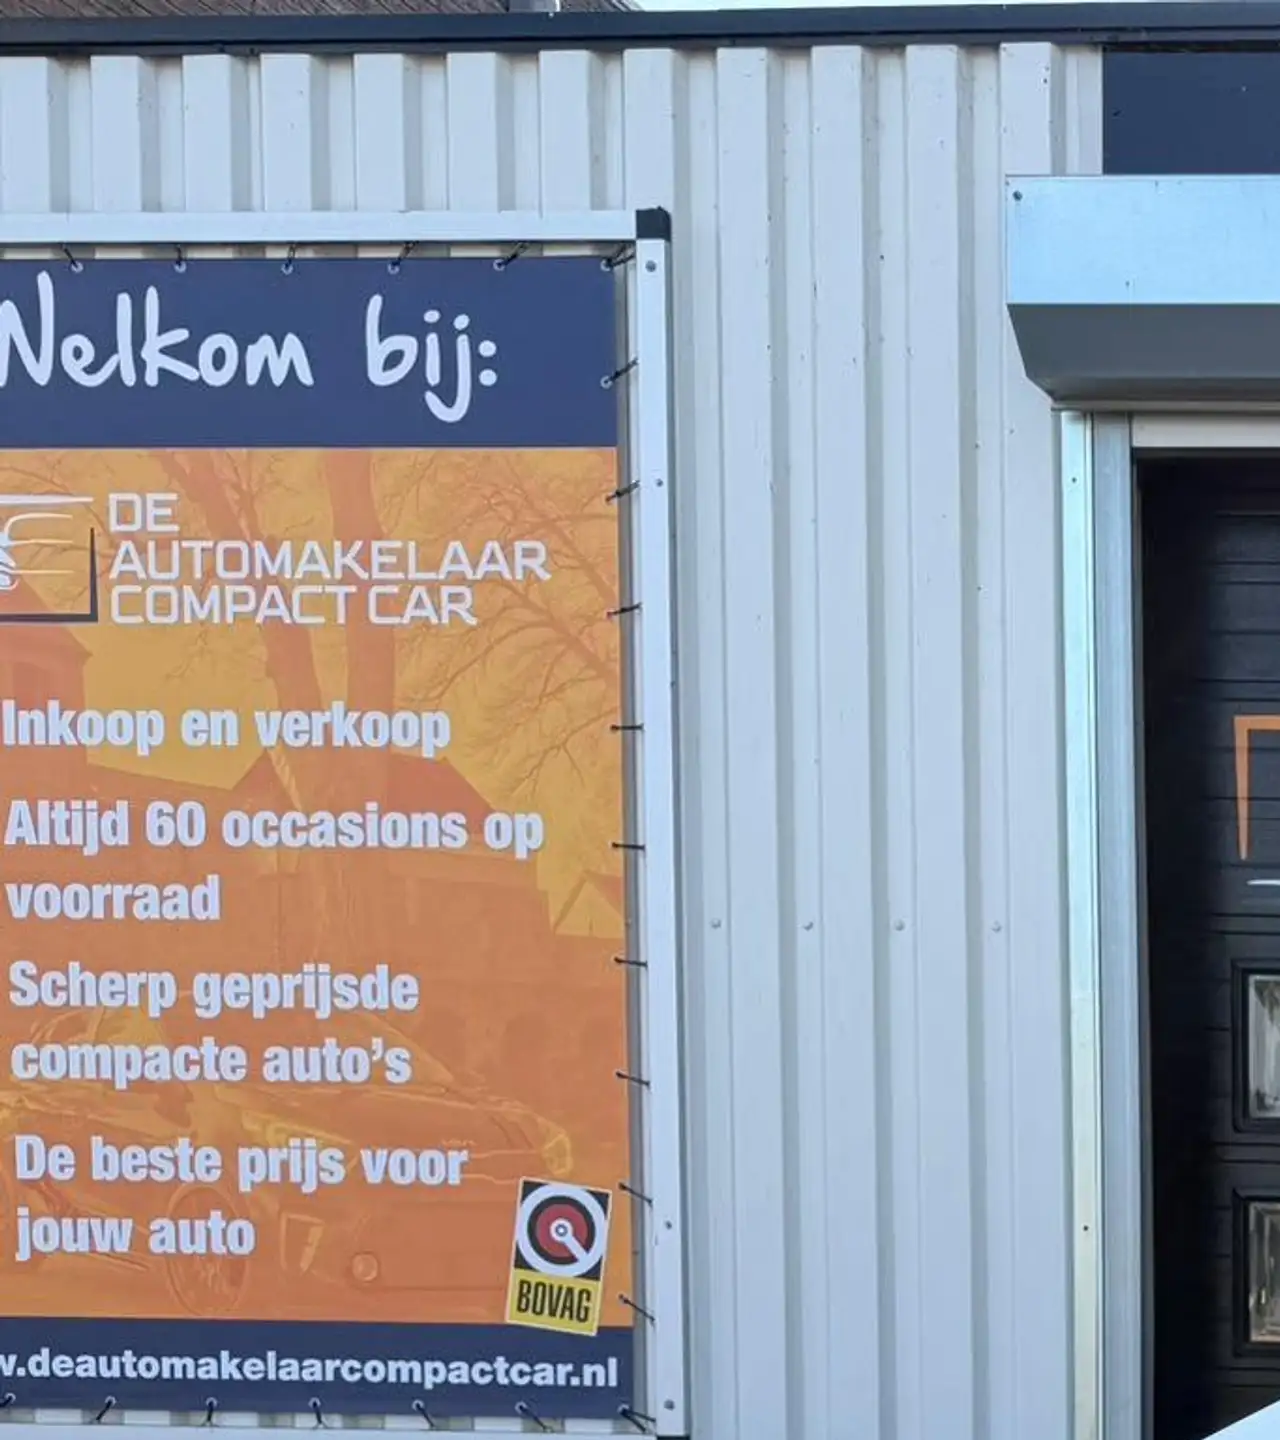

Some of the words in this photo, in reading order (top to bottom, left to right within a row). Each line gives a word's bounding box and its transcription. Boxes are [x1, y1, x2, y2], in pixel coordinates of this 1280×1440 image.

[366, 294, 497, 422] bij:
[109, 493, 179, 532] DE
[110, 541, 551, 580] AUTOMAKELAAR
[112, 585, 357, 624] COMPACT
[368, 585, 477, 625] CAR
[3, 700, 164, 756] Inkoop
[182, 710, 238, 746] en
[255, 701, 450, 758] verkoop
[4, 800, 129, 855] Altijd
[146, 801, 205, 846] 60
[222, 802, 467, 848] occasions
[484, 813, 543, 859] op
[6, 875, 220, 920] voorraad
[10, 960, 176, 1018] Scherp
[193, 964, 418, 1019] geprijsde
[12, 1037, 247, 1089] compacte
[263, 1038, 411, 1083] auto's
[16, 1135, 75, 1180] De
[92, 1136, 221, 1182] beste
[238, 1139, 345, 1193] prijs
[360, 1149, 468, 1185] voor
[16, 1207, 133, 1261] jouw
[150, 1210, 255, 1254] auto
[516, 1279, 592, 1324] BOVAG
